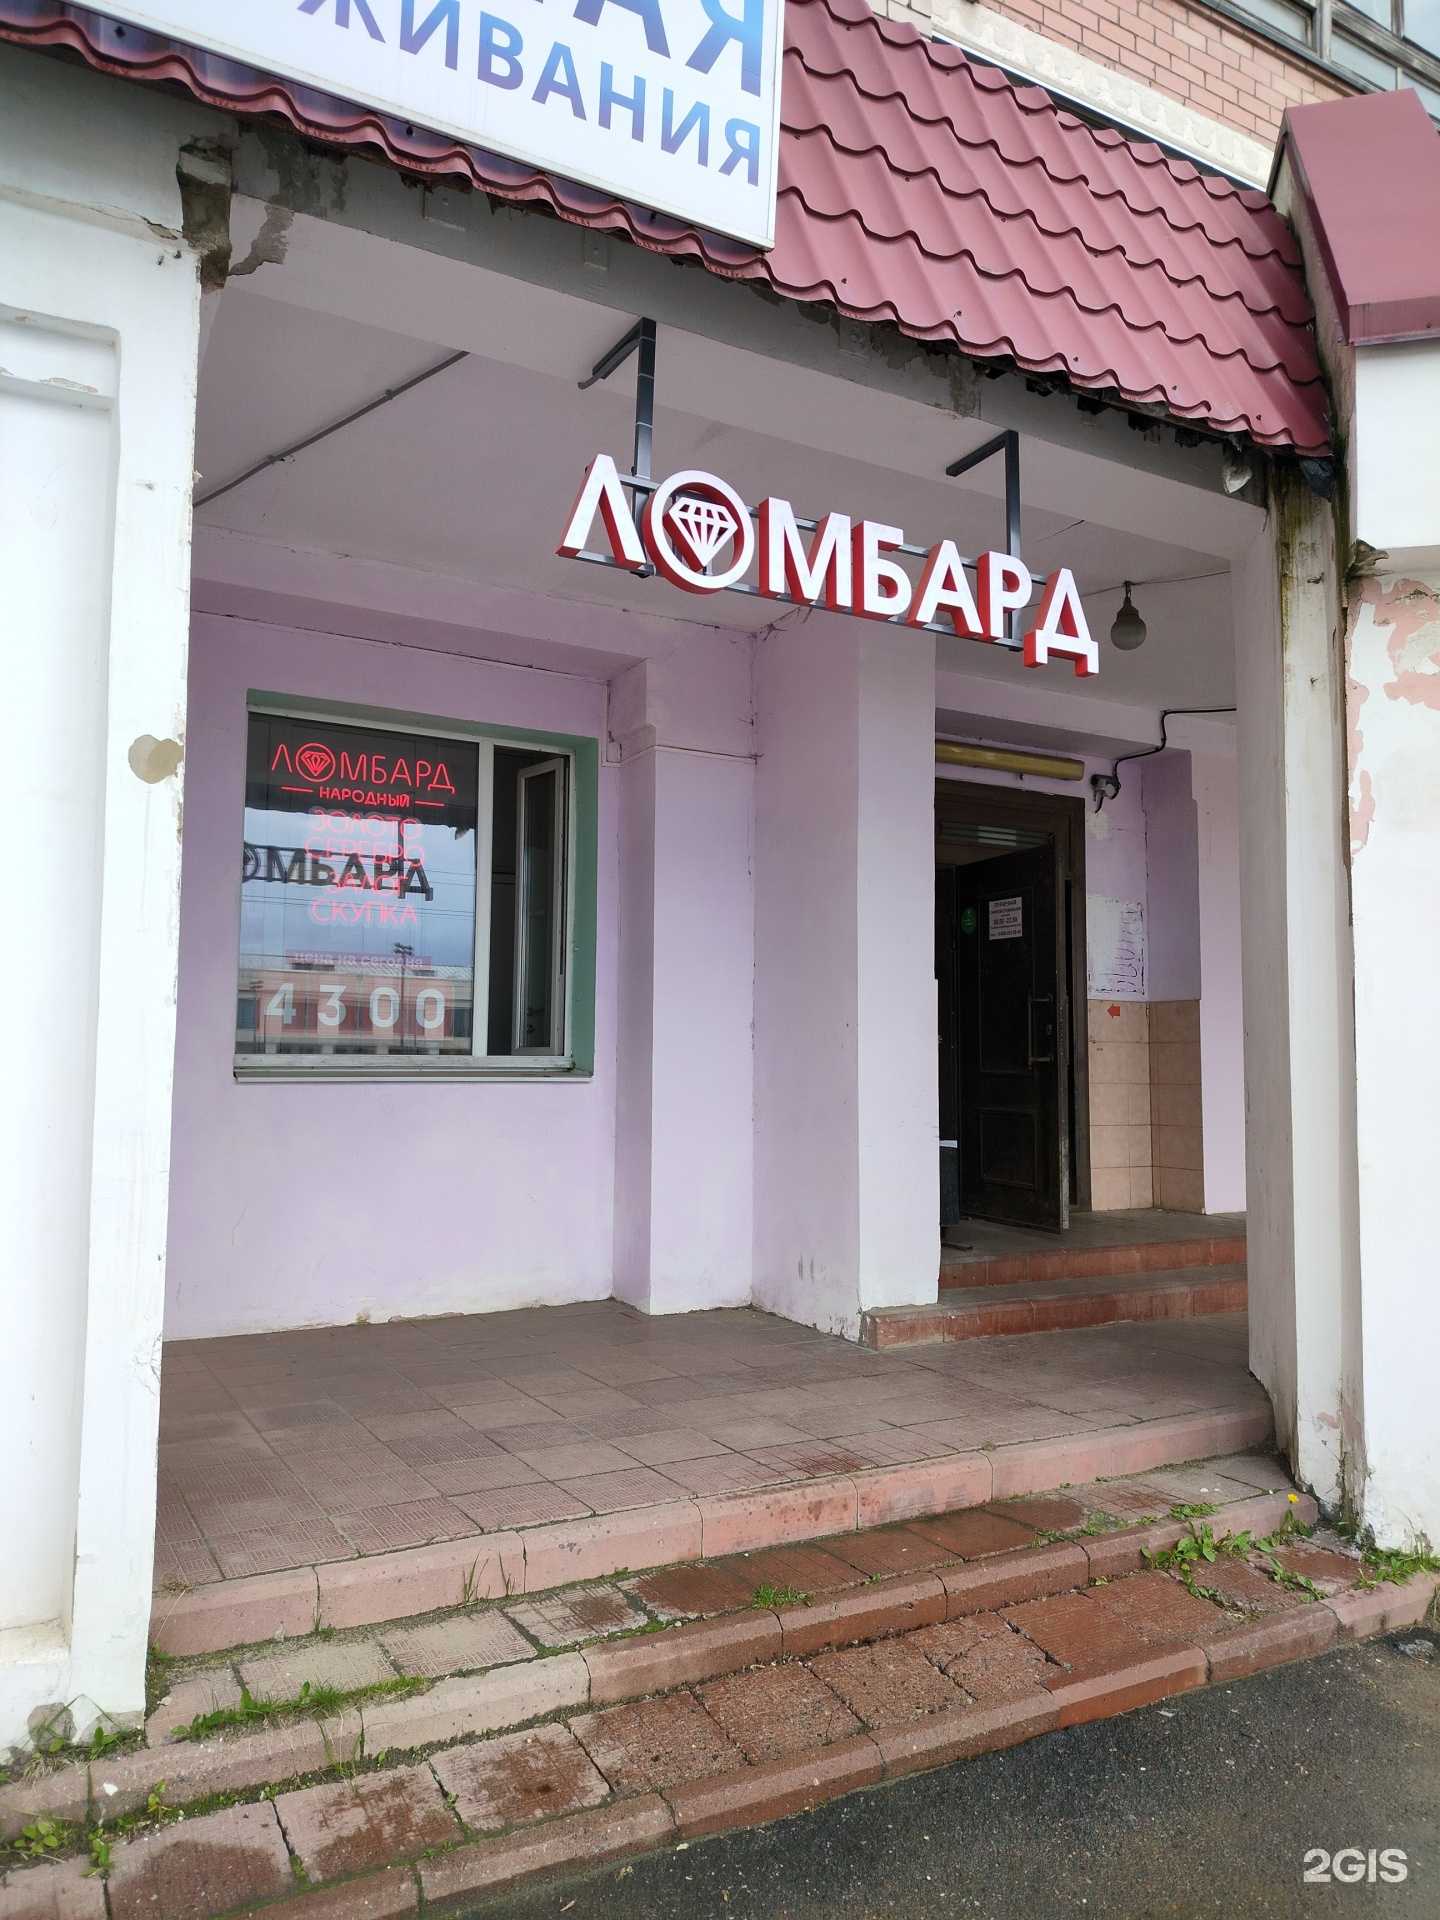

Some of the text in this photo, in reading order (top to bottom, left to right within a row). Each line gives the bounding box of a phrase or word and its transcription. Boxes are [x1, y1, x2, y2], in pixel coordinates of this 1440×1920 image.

[556, 453, 1100, 678] ЛОМБАРД
[271, 742, 455, 795] ЛОМБАРД
[319, 786, 410, 808] НАРОДНЫЙ
[307, 807, 420, 840] ЗОЛОТО
[311, 899, 418, 926] СКУПКА
[264, 983, 445, 1029] 4300
